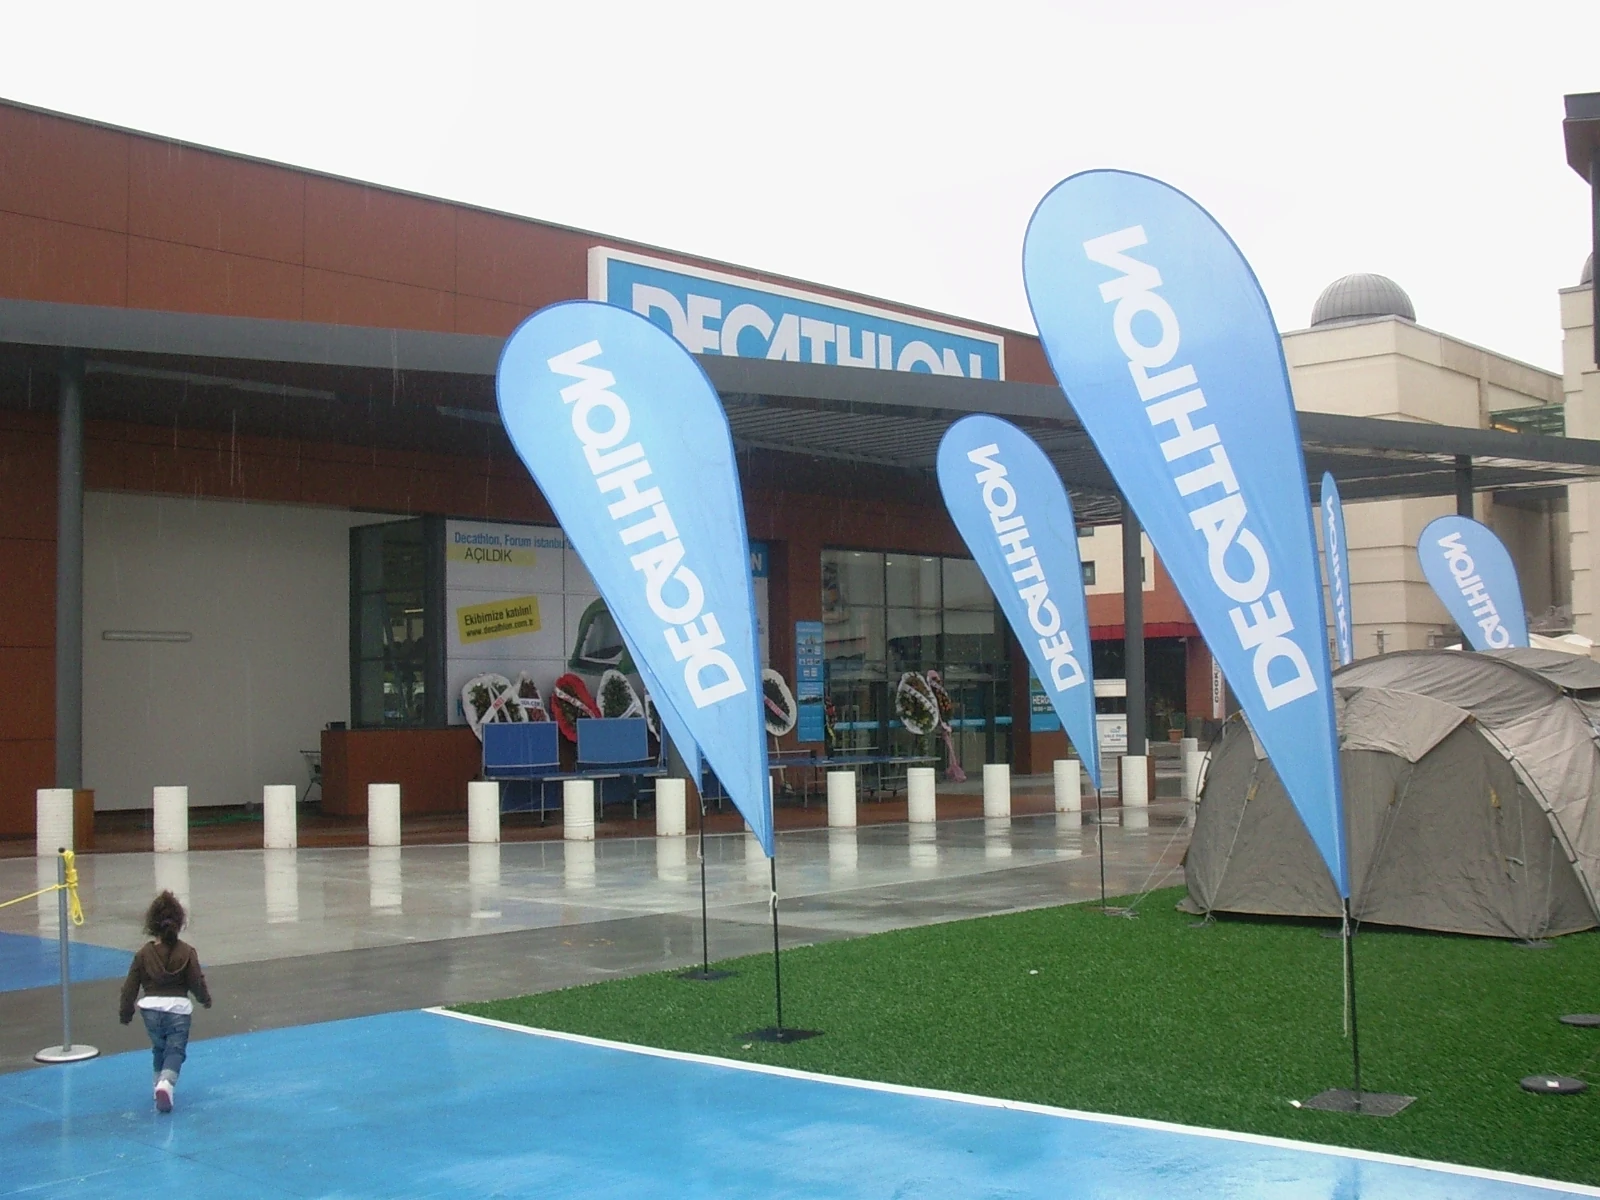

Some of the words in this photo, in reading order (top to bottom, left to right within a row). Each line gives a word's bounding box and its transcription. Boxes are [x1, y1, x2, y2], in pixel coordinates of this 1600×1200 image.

[505, 535, 532, 546] Forum
[464, 547, 513, 563] AÇILDIK
[464, 609, 504, 626] Ekibimize
